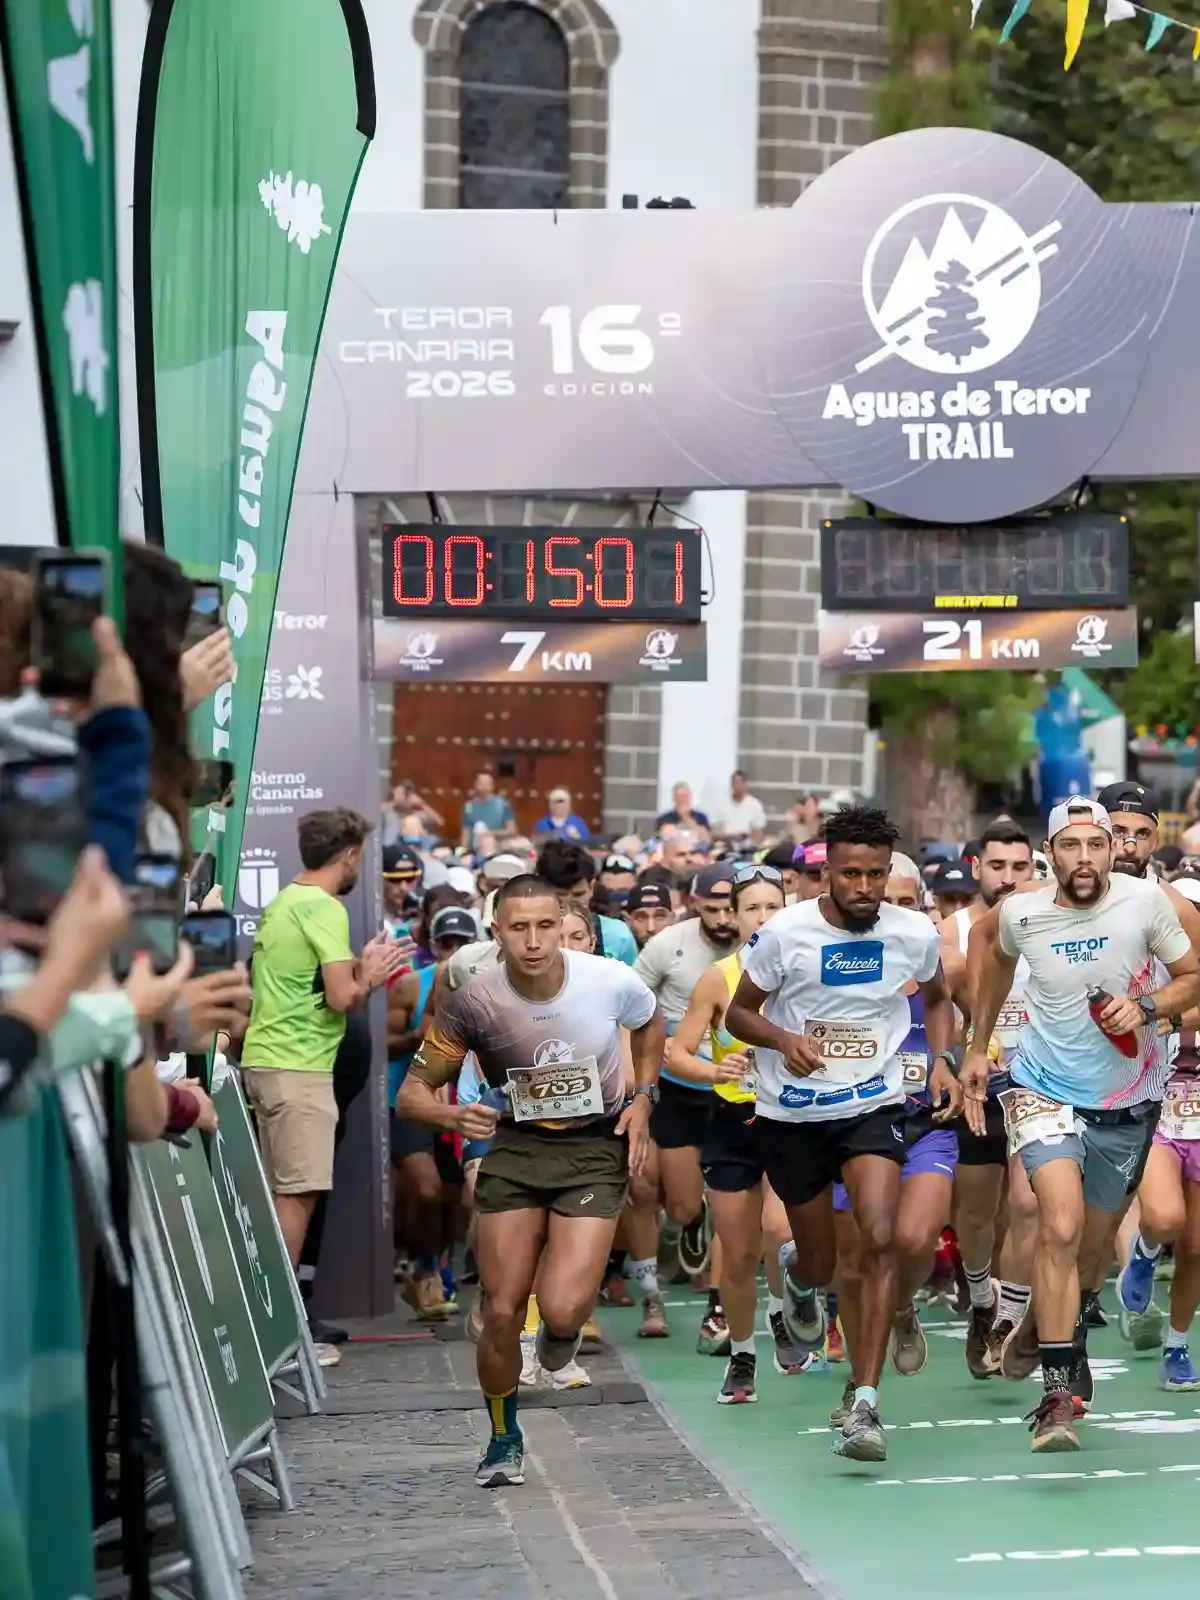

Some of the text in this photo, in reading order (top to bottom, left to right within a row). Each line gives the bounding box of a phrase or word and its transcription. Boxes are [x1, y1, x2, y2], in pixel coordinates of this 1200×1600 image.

[374, 306, 514, 330] TEROR
[339, 339, 515, 363] CANARIA
[406, 370, 516, 398] 2026
[822, 380, 1091, 426] Aguas de Teror
[902, 422, 1014, 461] TRAIL
[394, 535, 683, 607] 00:15:01
[500, 631, 592, 672] 7 KM
[923, 619, 983, 660] 21
[991, 638, 1039, 659] KM
[251, 771, 307, 785] bierno
[252, 785, 324, 800] Canarias
[822, 1041, 876, 1057] 1026
[535, 1079, 586, 1098] 703
